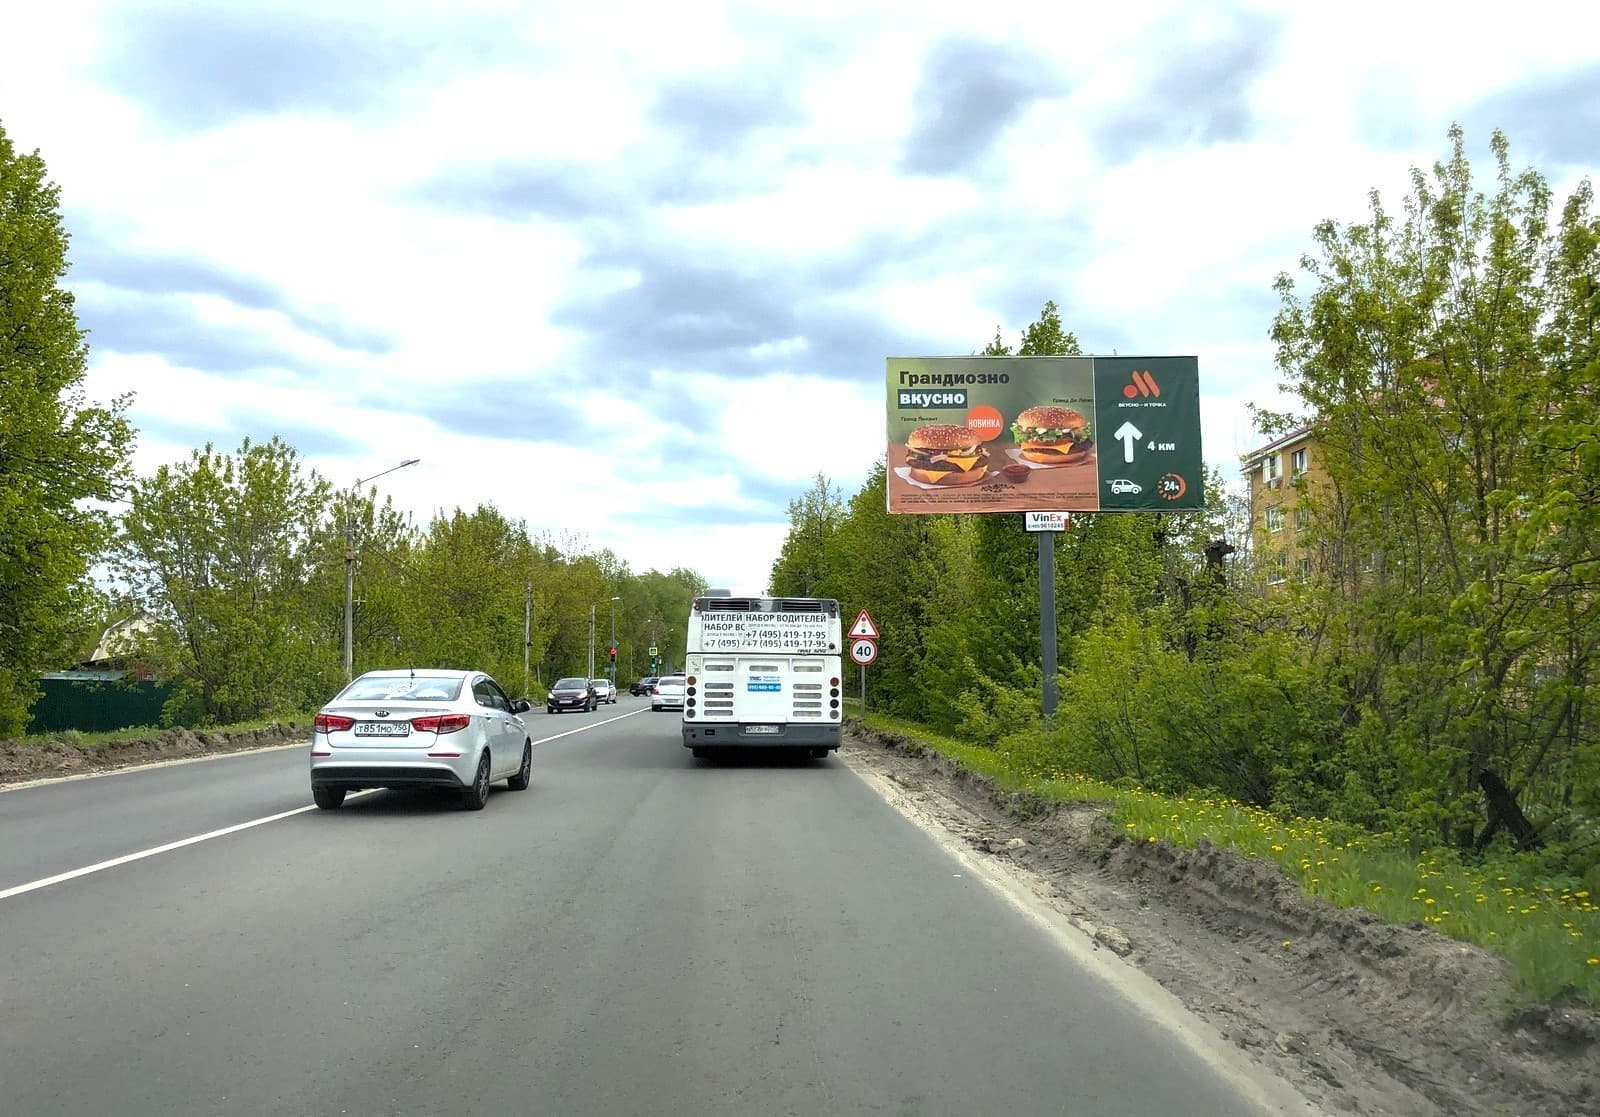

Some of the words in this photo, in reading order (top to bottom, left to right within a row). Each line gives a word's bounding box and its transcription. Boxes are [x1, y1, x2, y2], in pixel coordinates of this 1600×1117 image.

[900, 371, 1010, 387] Грандиозно
[900, 393, 965, 407] вкусно
[968, 419, 1001, 428] НОВИНКА
[1147, 441, 1156, 451] 4
[1158, 443, 1176, 451] км
[1032, 513, 1062, 522] VinEx
[745, 614, 774, 622] НАБОР
[776, 613, 827, 623] ВОДИТЕЛЕЙ
[704, 623, 734, 631] НАБОР
[745, 630, 757, 639] +7
[759, 630, 782, 640] (495)
[783, 630, 826, 639] 419-17-95
[704, 639, 716, 647] +7
[717, 639, 740, 649] (495)
[746, 639, 758, 648] +7
[759, 639, 782, 649] (495)
[783, 639, 827, 648] 419-17-95
[856, 646, 872, 657] 40
